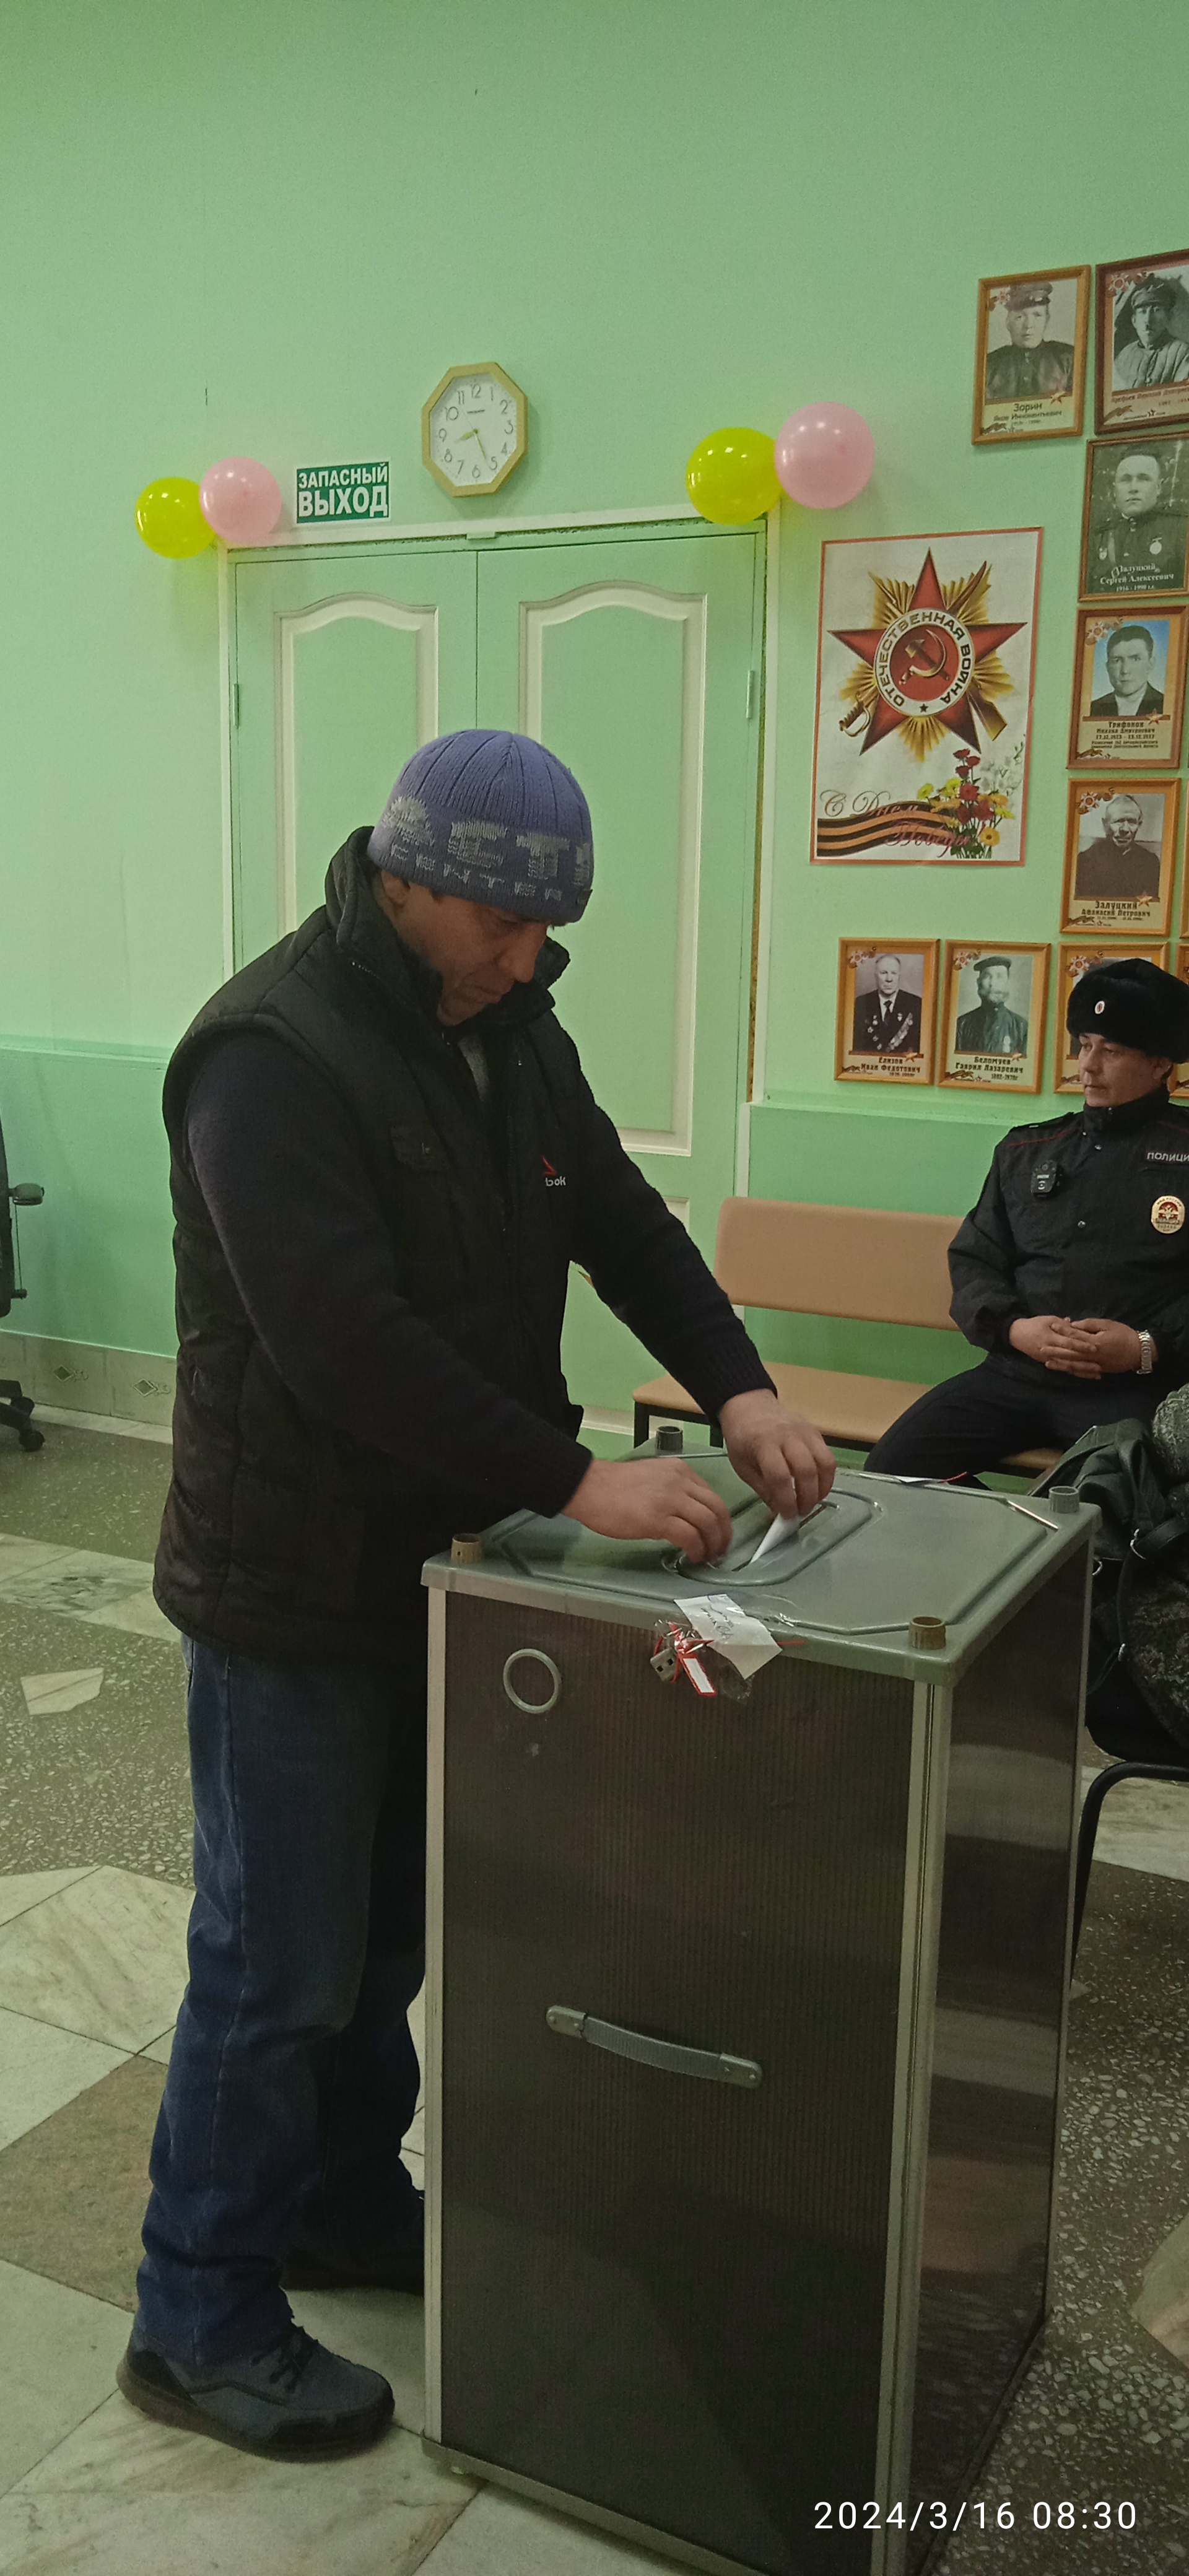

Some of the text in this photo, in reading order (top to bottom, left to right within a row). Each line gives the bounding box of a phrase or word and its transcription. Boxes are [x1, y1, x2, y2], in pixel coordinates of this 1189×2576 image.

[457, 390, 465, 405] 11
[471, 383, 481, 399] 12
[490, 386, 494, 402] 1
[444, 406, 459, 422] 10
[500, 399, 508, 415] 2
[1013, 402, 1043, 413] Зорин
[438, 427, 447, 443] 9
[504, 420, 513, 435] 3
[444, 448, 453, 463] 8
[501, 442, 508, 455] 4
[457, 459, 464, 475] 7
[489, 456, 498, 471] 5
[298, 463, 388, 489] ЗАПАСНЫЙ
[472, 464, 481, 479] 6
[298, 485, 388, 518] ВЫХОД
[1118, 563, 1156, 573] Залуцкий
[1100, 573, 1175, 586] Сергей Алексеевич
[879, 611, 965, 707] ОТЕЧЕСТВЕННАЯ
[820, 790, 847, 817] С
[1094, 900, 1138, 910] Залуцкий
[983, 1064, 1024, 1074] Лазаревич
[1147, 1152, 1189, 1162] ПОЛИЦИ
